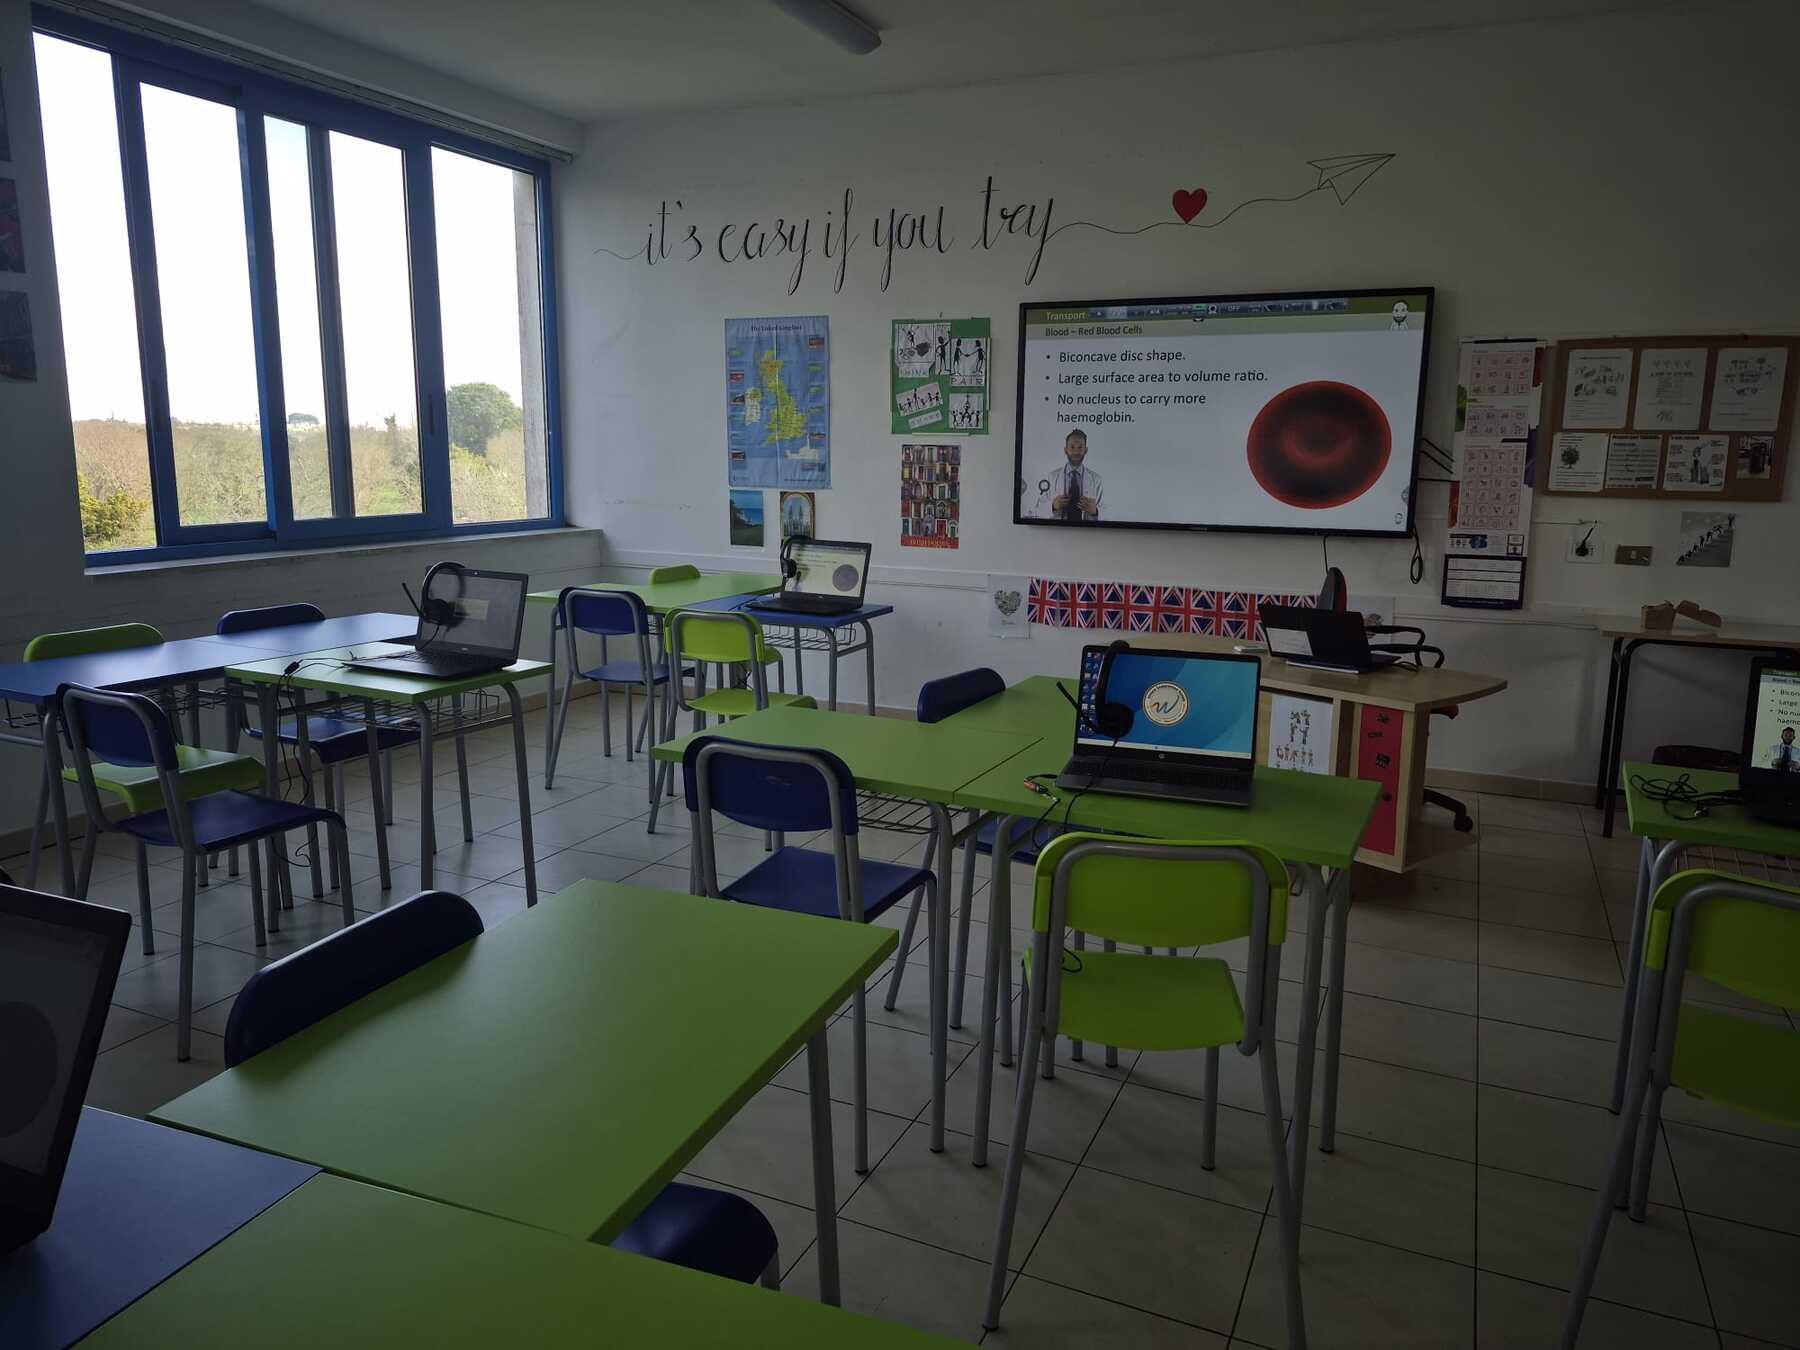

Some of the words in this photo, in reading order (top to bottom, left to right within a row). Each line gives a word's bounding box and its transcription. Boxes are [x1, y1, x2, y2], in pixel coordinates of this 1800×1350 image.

[645, 200, 703, 265] it's
[718, 218, 812, 296] easy
[824, 188, 860, 294] if
[872, 206, 955, 293] you
[972, 176, 1054, 286] try
[1046, 311, 1086, 321] Transport
[1045, 327, 1069, 337] Blood
[1078, 327, 1093, 335] Red
[1096, 326, 1121, 335] Blood
[1123, 325, 1143, 334] Cells
[1059, 351, 1116, 362] Biconcave
[1120, 350, 1143, 361] disc
[1146, 349, 1186, 363] shape.
[951, 377, 983, 385] PAIR
[1058, 373, 1089, 386] Large
[1091, 371, 1134, 383] surface
[1137, 374, 1164, 383] area
[1168, 372, 1180, 382] to
[1184, 370, 1230, 382] volume
[1233, 370, 1267, 381] ratio.
[1057, 394, 1073, 404] No
[1076, 393, 1121, 404] nucleus
[1124, 394, 1136, 404] to
[1139, 395, 1170, 406] carry
[1173, 395, 1206, 404] more
[1056, 411, 1135, 425] haemoglobin.
